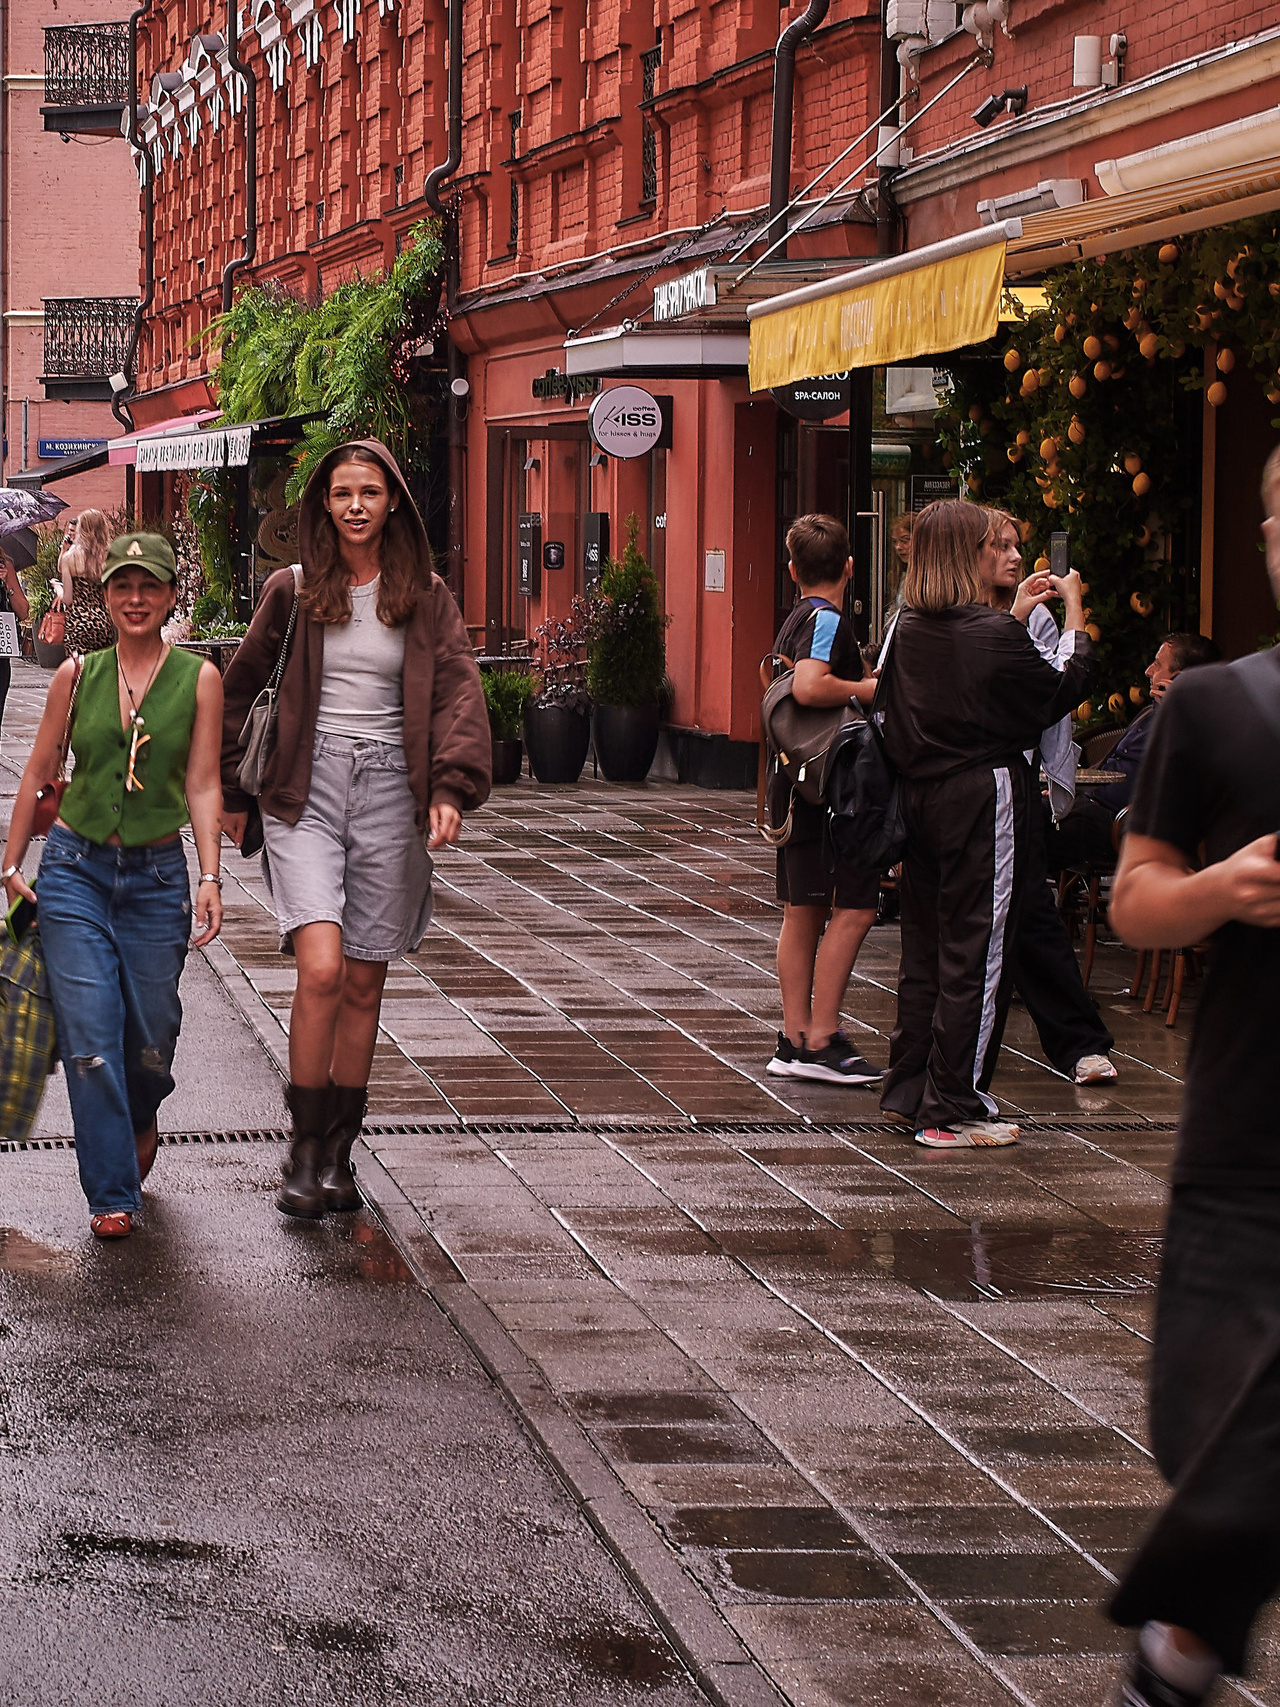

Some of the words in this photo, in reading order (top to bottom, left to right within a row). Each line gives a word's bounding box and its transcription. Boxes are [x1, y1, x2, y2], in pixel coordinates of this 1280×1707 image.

[794, 391, 841, 401] SPA-САЛОН
[632, 430, 638, 438] &
[640, 430, 657, 438] hugs
[54, 441, 99, 451] КОЗИХИНСК
[5, 624, 13, 654] Drop
